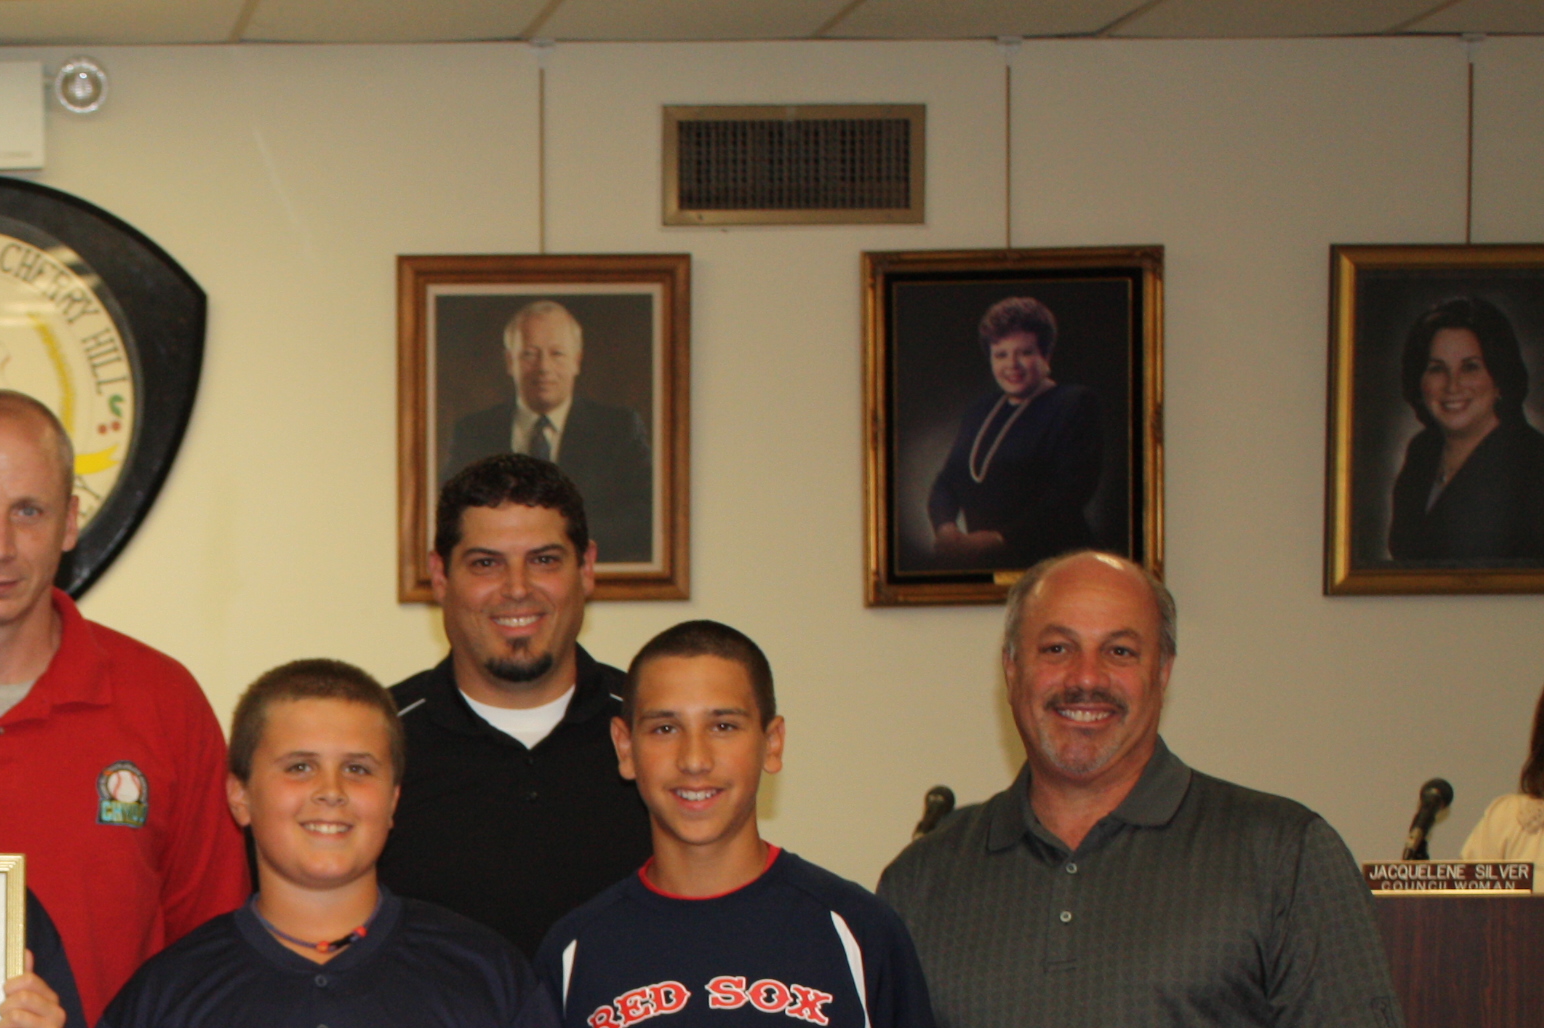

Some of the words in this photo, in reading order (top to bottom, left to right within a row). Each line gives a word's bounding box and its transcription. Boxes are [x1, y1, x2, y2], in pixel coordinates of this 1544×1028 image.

[80, 328, 129, 396] HILL
[1368, 864, 1467, 880] JACQUELENE
[1474, 864, 1530, 880] SILVER
[704, 976, 833, 1026] SOX
